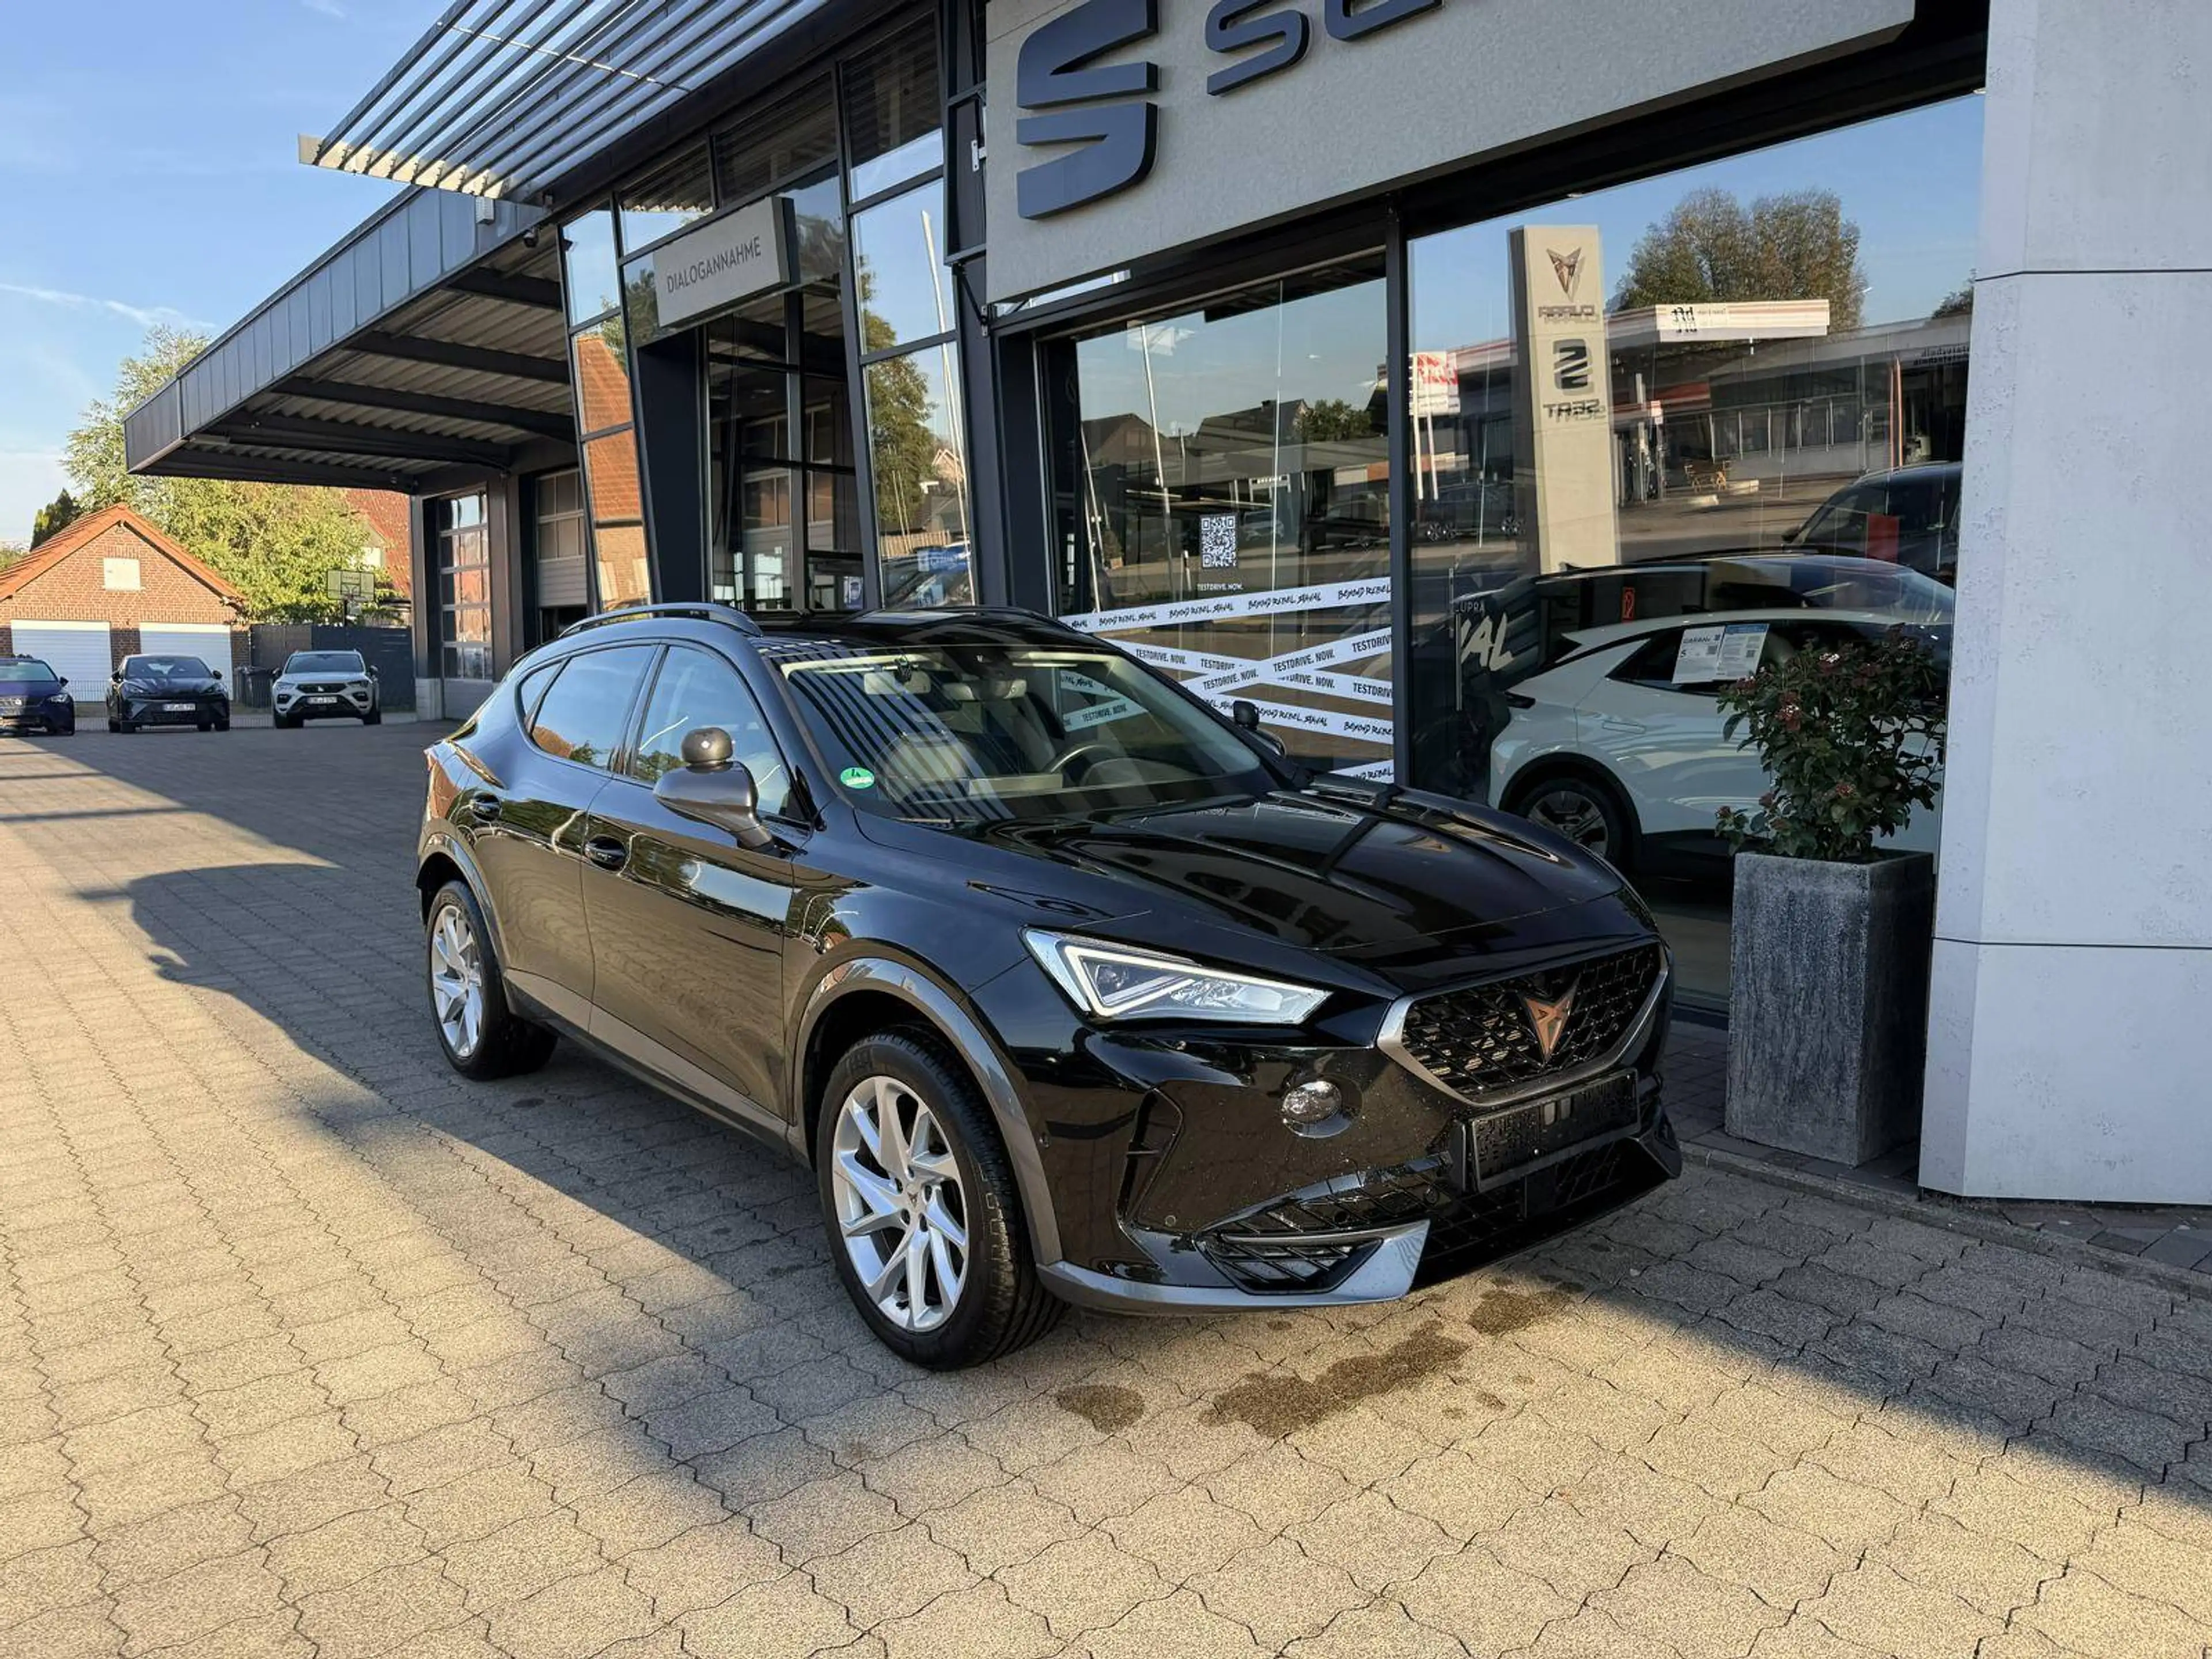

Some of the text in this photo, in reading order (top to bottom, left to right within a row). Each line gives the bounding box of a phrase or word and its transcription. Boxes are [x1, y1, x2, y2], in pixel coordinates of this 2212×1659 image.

[1205, 0, 1446, 96] S
[667, 236, 762, 293] DIALOGANNAHME
[1455, 600, 1486, 616] UPRA
[1352, 634, 1392, 653] TESTDRIV
[1135, 648, 1187, 664] TESTDRIVE. NOW.
[1273, 649, 1335, 673] TESTDRIVE. NOW.
[1203, 668, 1259, 690] TESTDRIVE. NOW.
[1315, 676, 1335, 688] NOW.
[1353, 682, 1393, 698] TESTDRIV
[1257, 707, 1278, 719] EYOND
[1371, 725, 1393, 736] REBE
